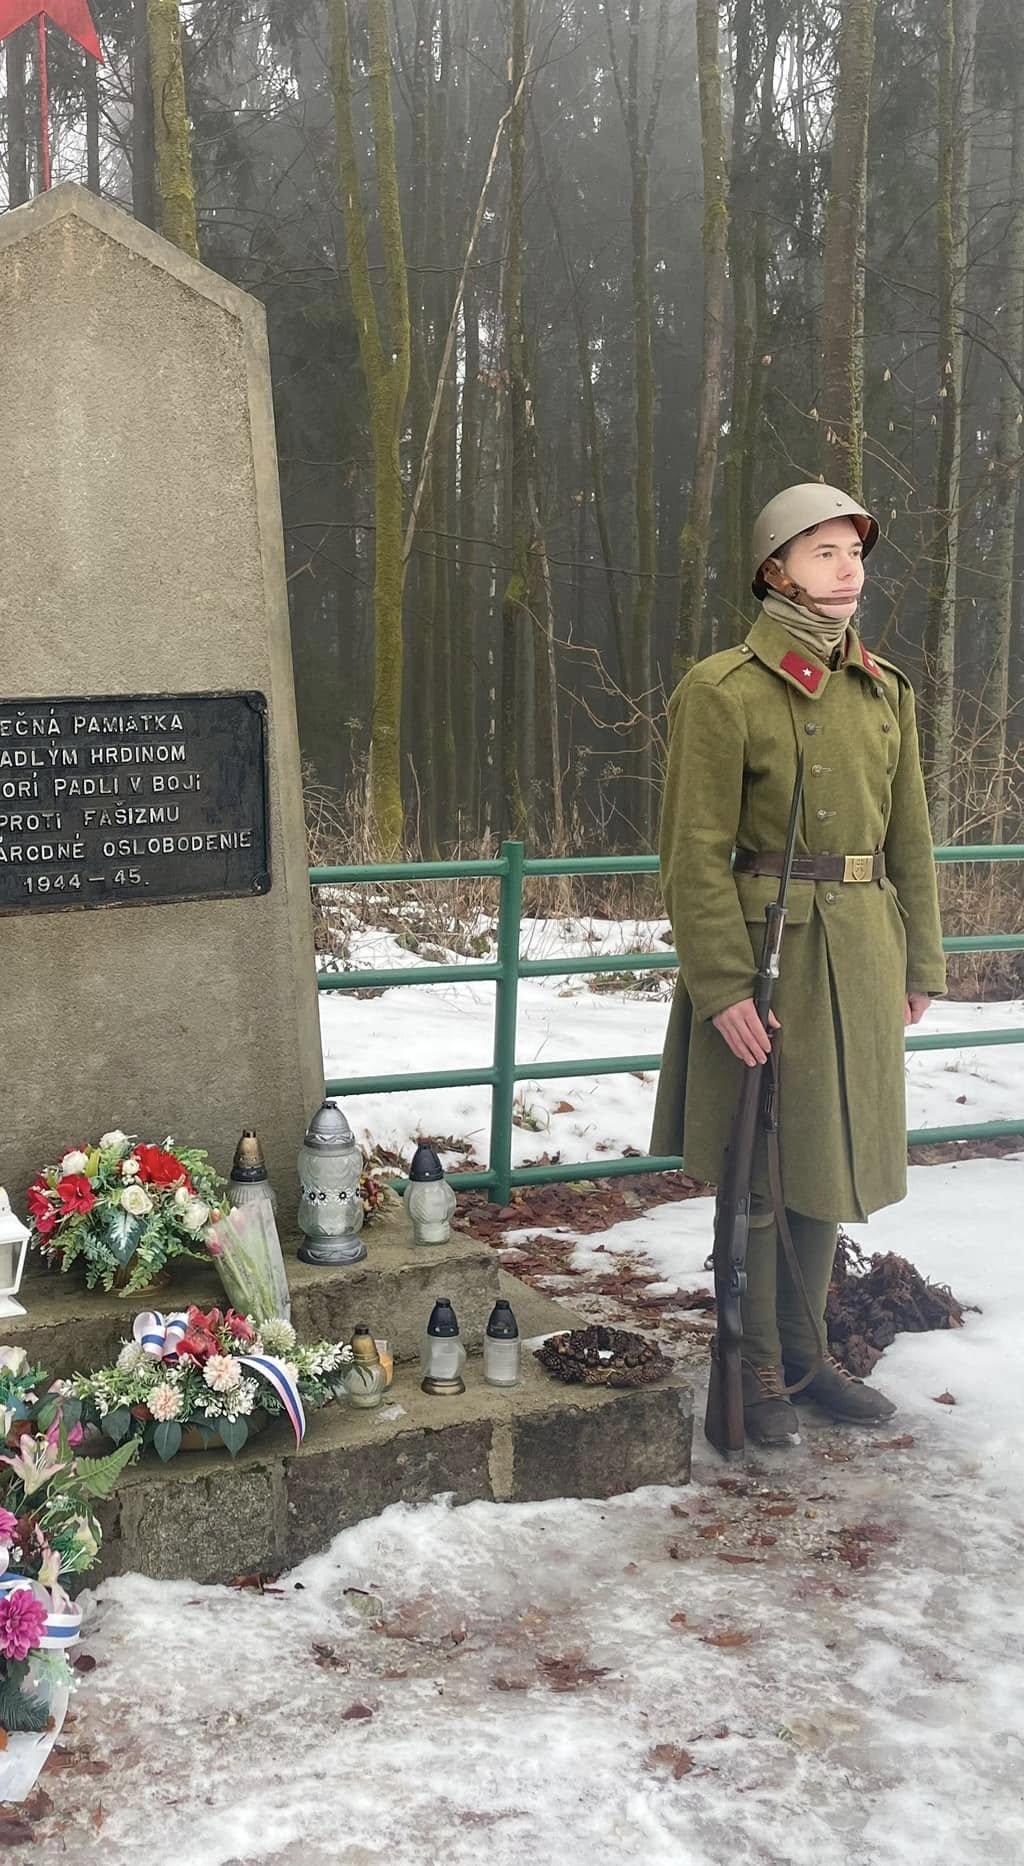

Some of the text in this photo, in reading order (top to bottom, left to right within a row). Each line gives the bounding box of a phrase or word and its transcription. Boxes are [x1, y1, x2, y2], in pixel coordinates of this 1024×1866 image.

[73, 714, 183, 735] PAMIATKA
[90, 745, 186, 764] HRDINOM
[54, 778, 119, 797] PADLI
[129, 776, 142, 792] V
[83, 800, 180, 826] FAŠIZMU
[103, 831, 252, 857] OSLOBODENIE
[23, 873, 82, 893] 1944
[114, 868, 151, 886] 45.
